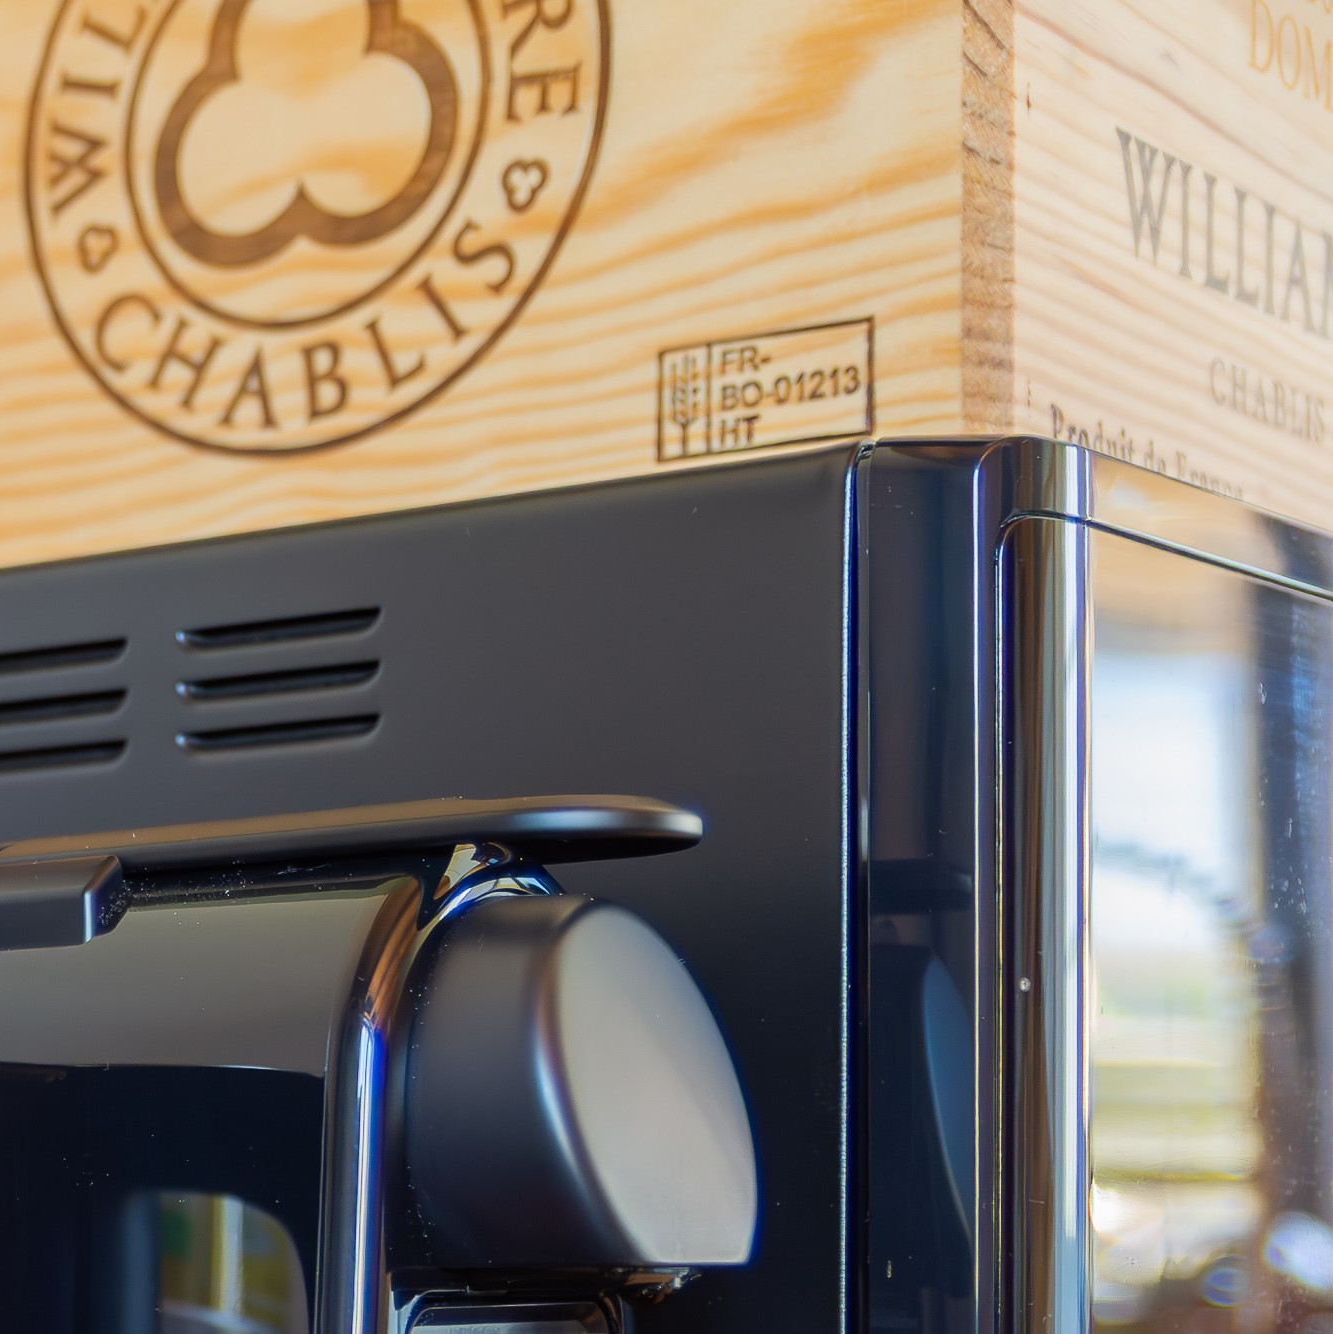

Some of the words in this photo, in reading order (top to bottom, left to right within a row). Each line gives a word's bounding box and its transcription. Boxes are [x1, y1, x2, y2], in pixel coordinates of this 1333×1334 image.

[92, 219, 519, 432] CHABLIS
[720, 365, 861, 411] BO-01213
[1210, 356, 1326, 446] CHABLIS
[719, 414, 761, 446] HT
